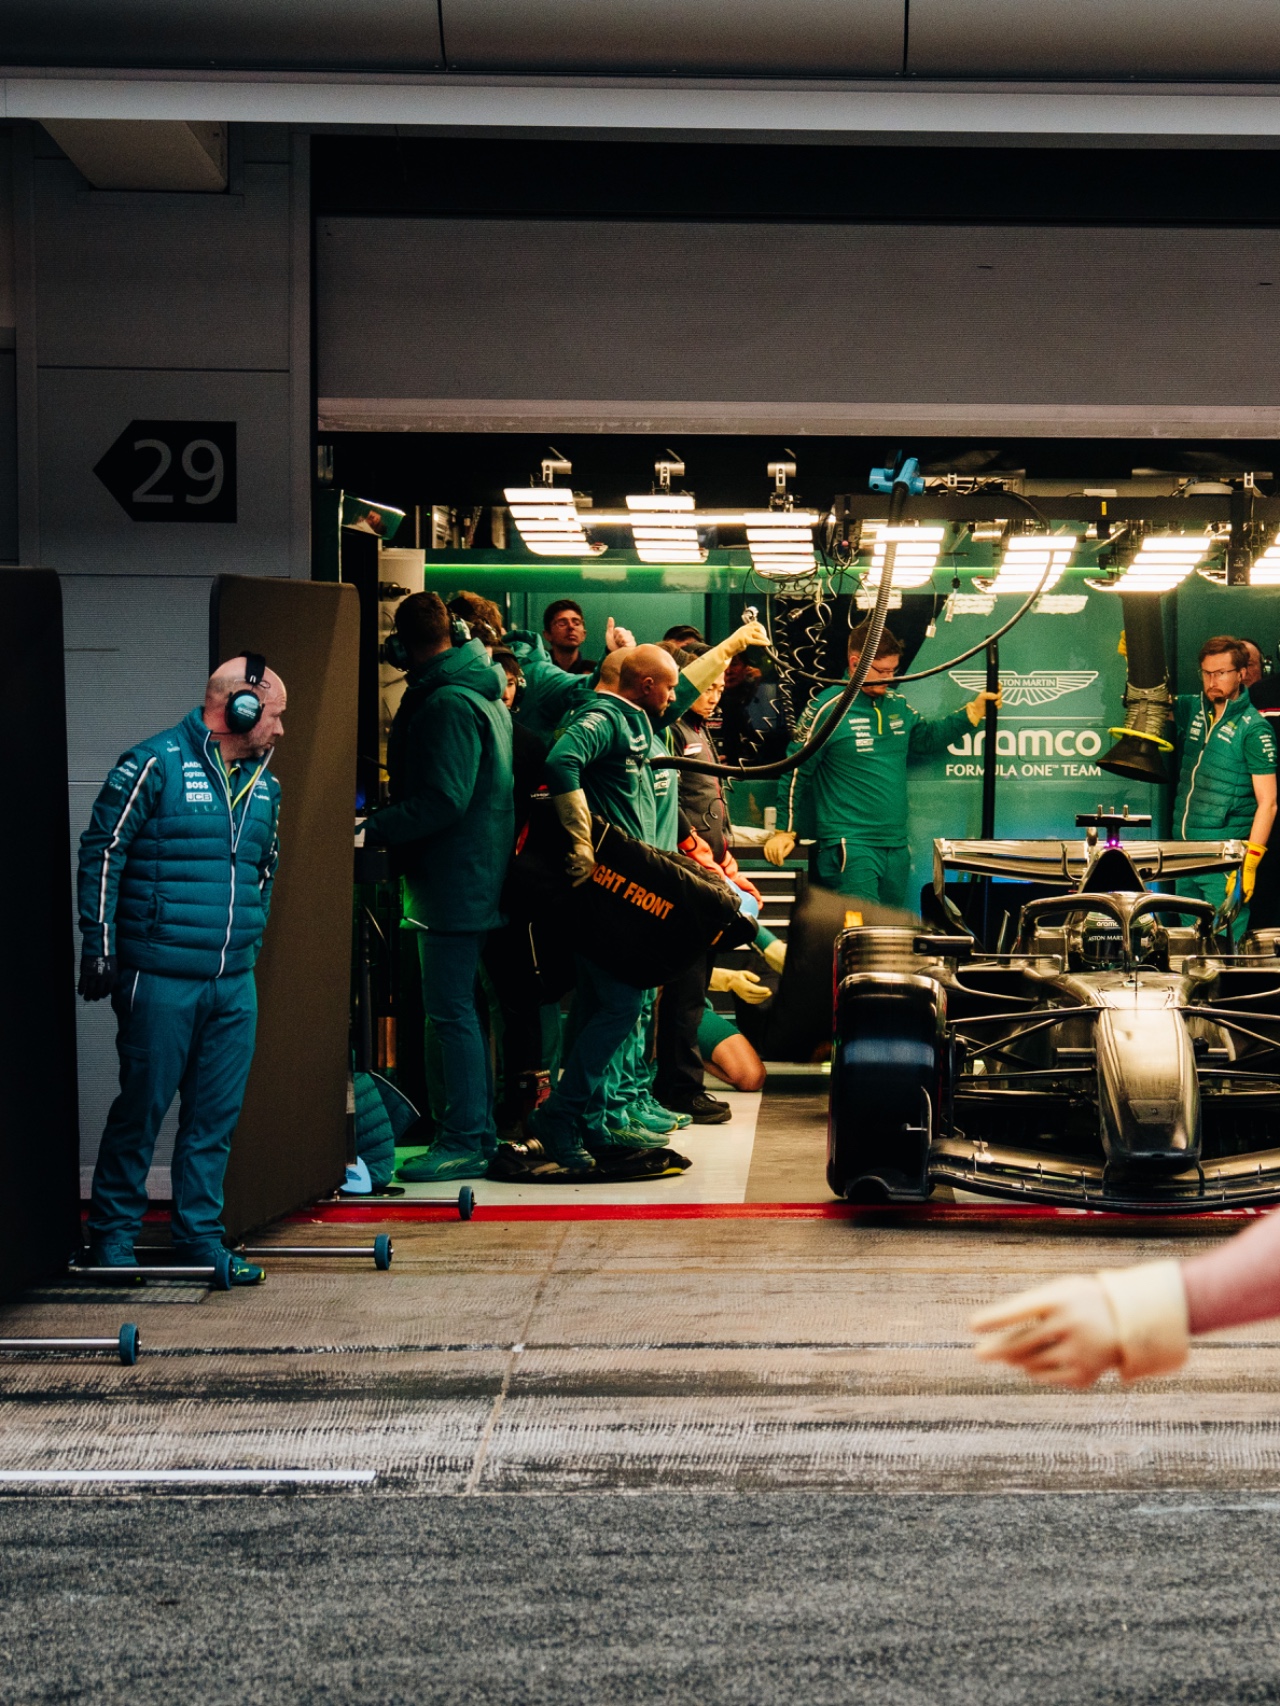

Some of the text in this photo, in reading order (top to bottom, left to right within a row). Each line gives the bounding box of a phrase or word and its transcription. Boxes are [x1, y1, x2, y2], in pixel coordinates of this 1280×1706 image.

[132, 438, 225, 505] 29
[999, 678, 1056, 687] STON MARTIN
[946, 729, 1102, 757] aramco
[1061, 764, 1102, 777] TEAM
[185, 781, 209, 790] BOSS
[187, 793, 212, 802] JCB
[591, 862, 675, 920] IGHT FRONT
